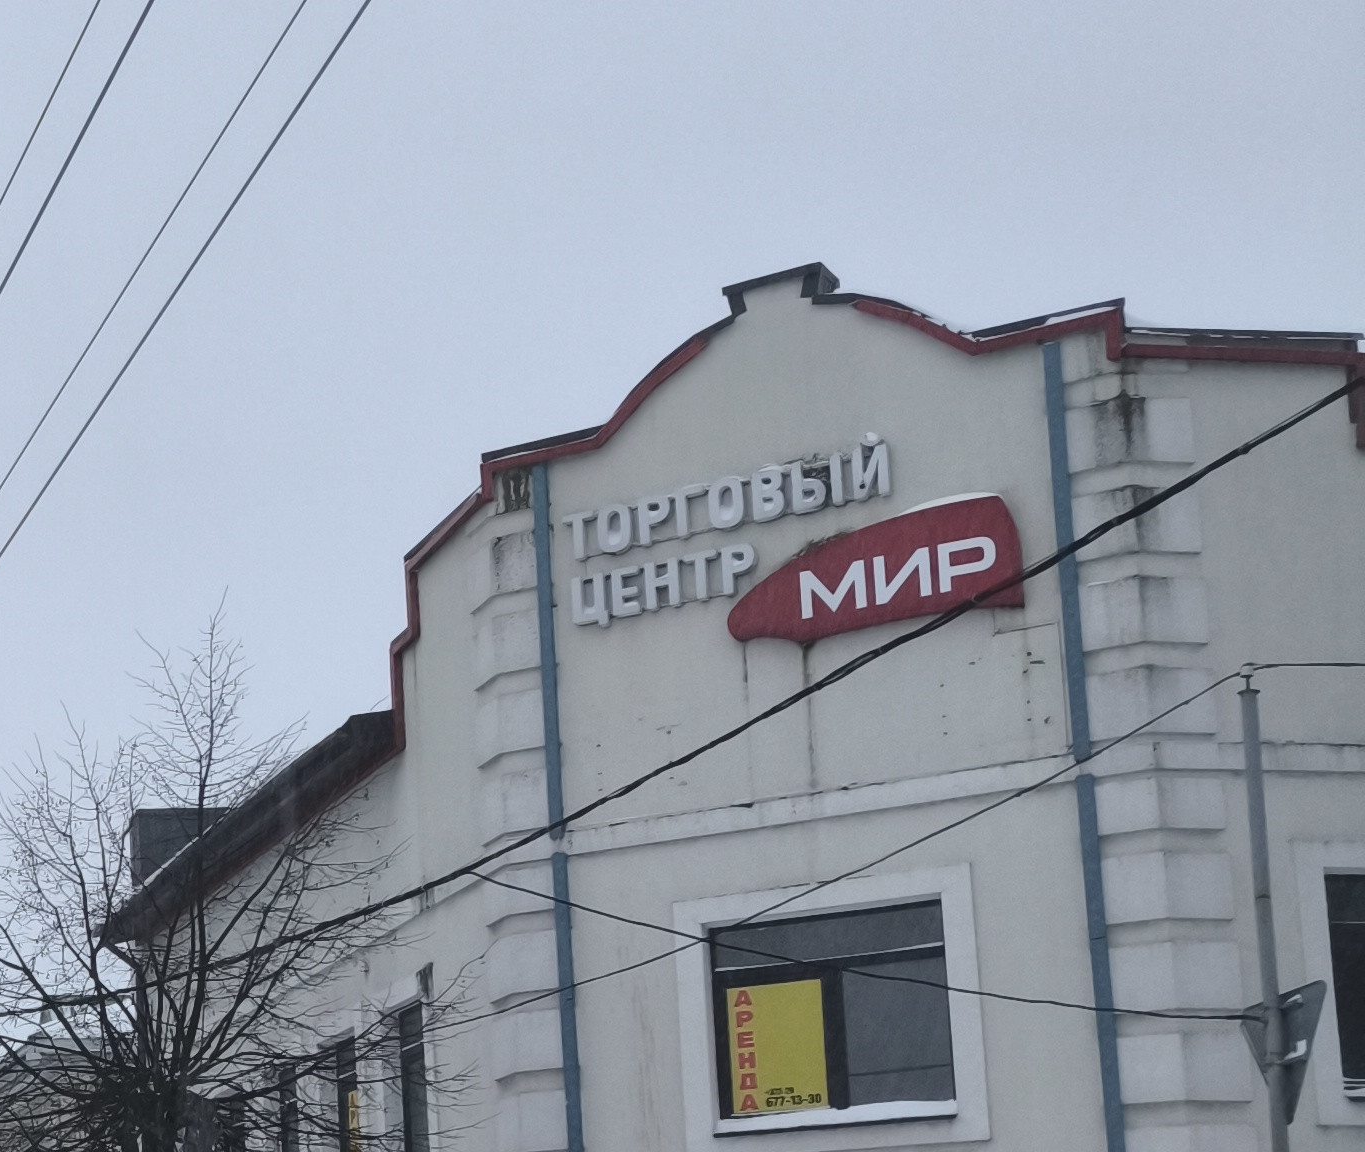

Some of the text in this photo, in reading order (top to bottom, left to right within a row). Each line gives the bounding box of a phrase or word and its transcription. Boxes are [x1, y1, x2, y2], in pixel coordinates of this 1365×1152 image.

[563, 432, 892, 561] ТОРГОВЫЙ
[571, 544, 755, 627] ЦЕНТР
[799, 536, 996, 620] МИР
[734, 990, 759, 1112] АРЕНДА
